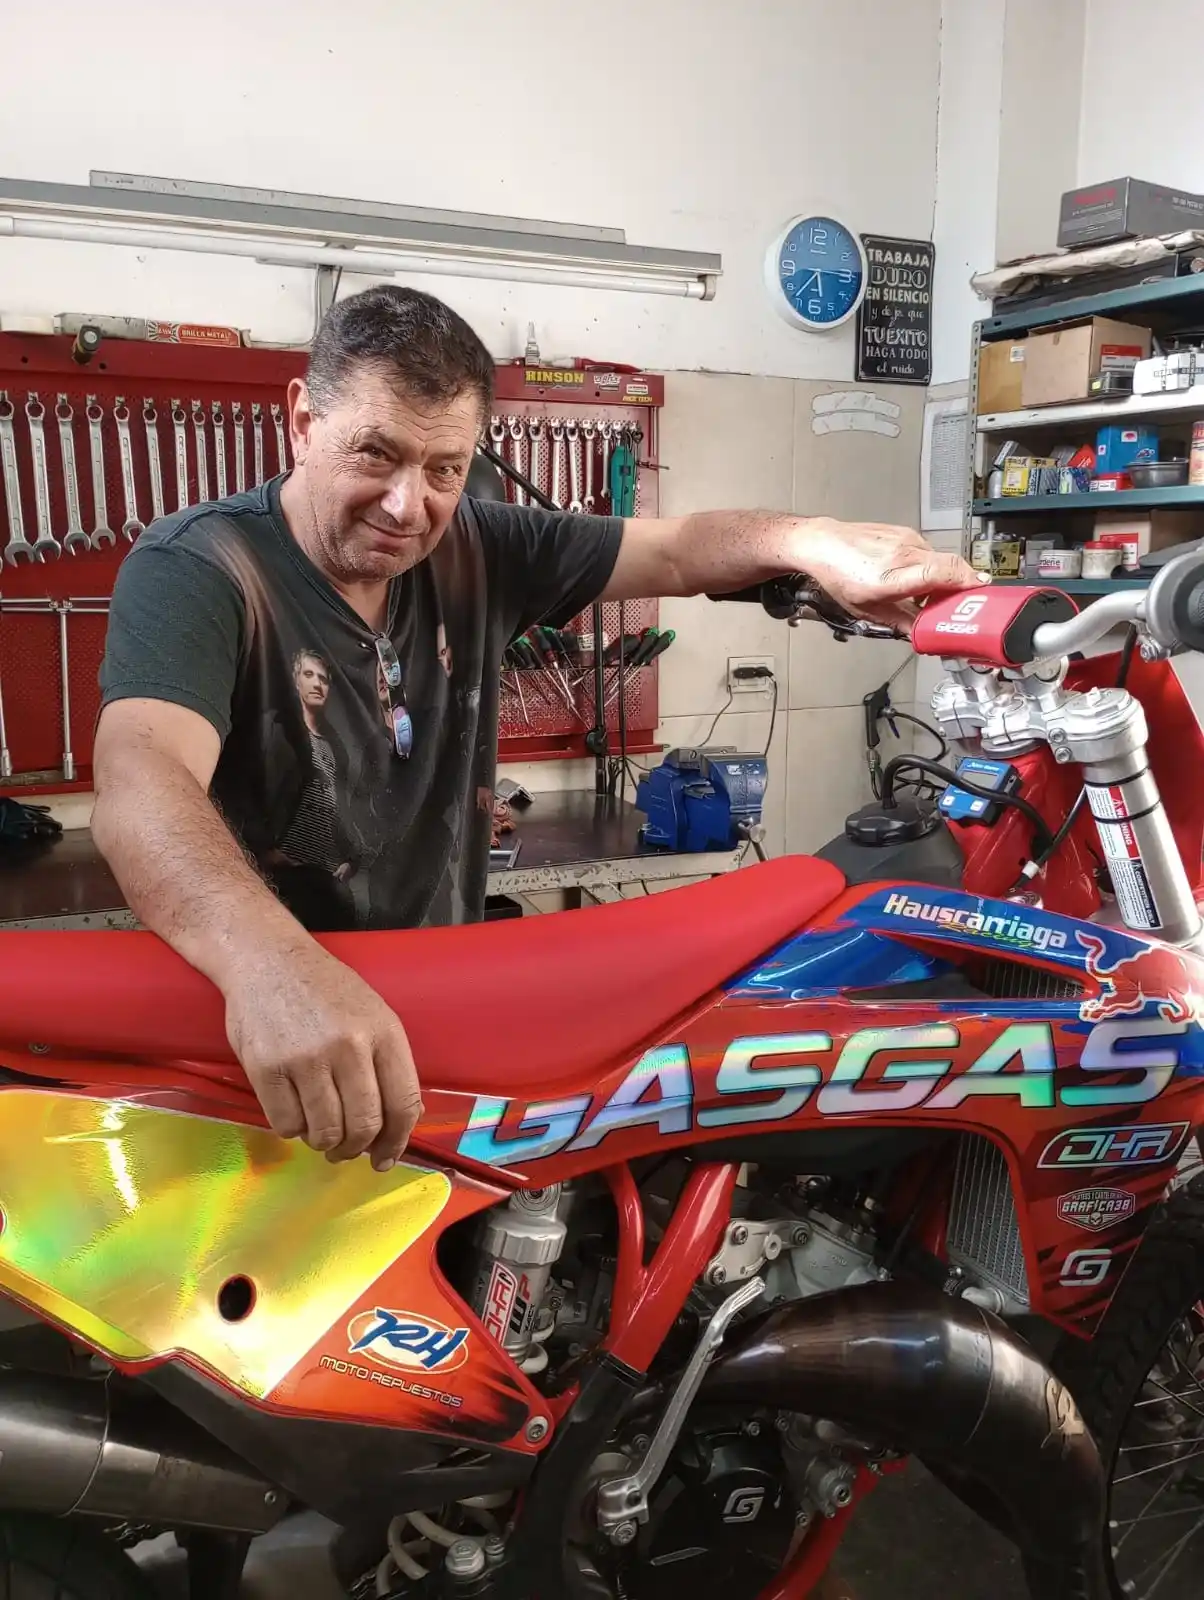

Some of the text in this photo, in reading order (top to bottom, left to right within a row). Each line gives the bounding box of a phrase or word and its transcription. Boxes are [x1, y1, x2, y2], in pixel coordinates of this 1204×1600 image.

[808, 227, 828, 246] 12
[867, 248, 930, 268] TRABAJA
[781, 259, 796, 277] 9
[838, 267, 852, 284] 3
[870, 265, 927, 289] DURO
[865, 286, 929, 304] EN SILENCIO
[807, 298, 822, 315] 6
[864, 325, 886, 344] TU
[866, 345, 929, 360] HAGA TODO
[935, 621, 980, 635] GASGAS
[882, 893, 1068, 950] Hauscarriaga
[1061, 1198, 1132, 1213] GRAFICA38
[319, 1355, 463, 1408] MOTO REPUESTOS
